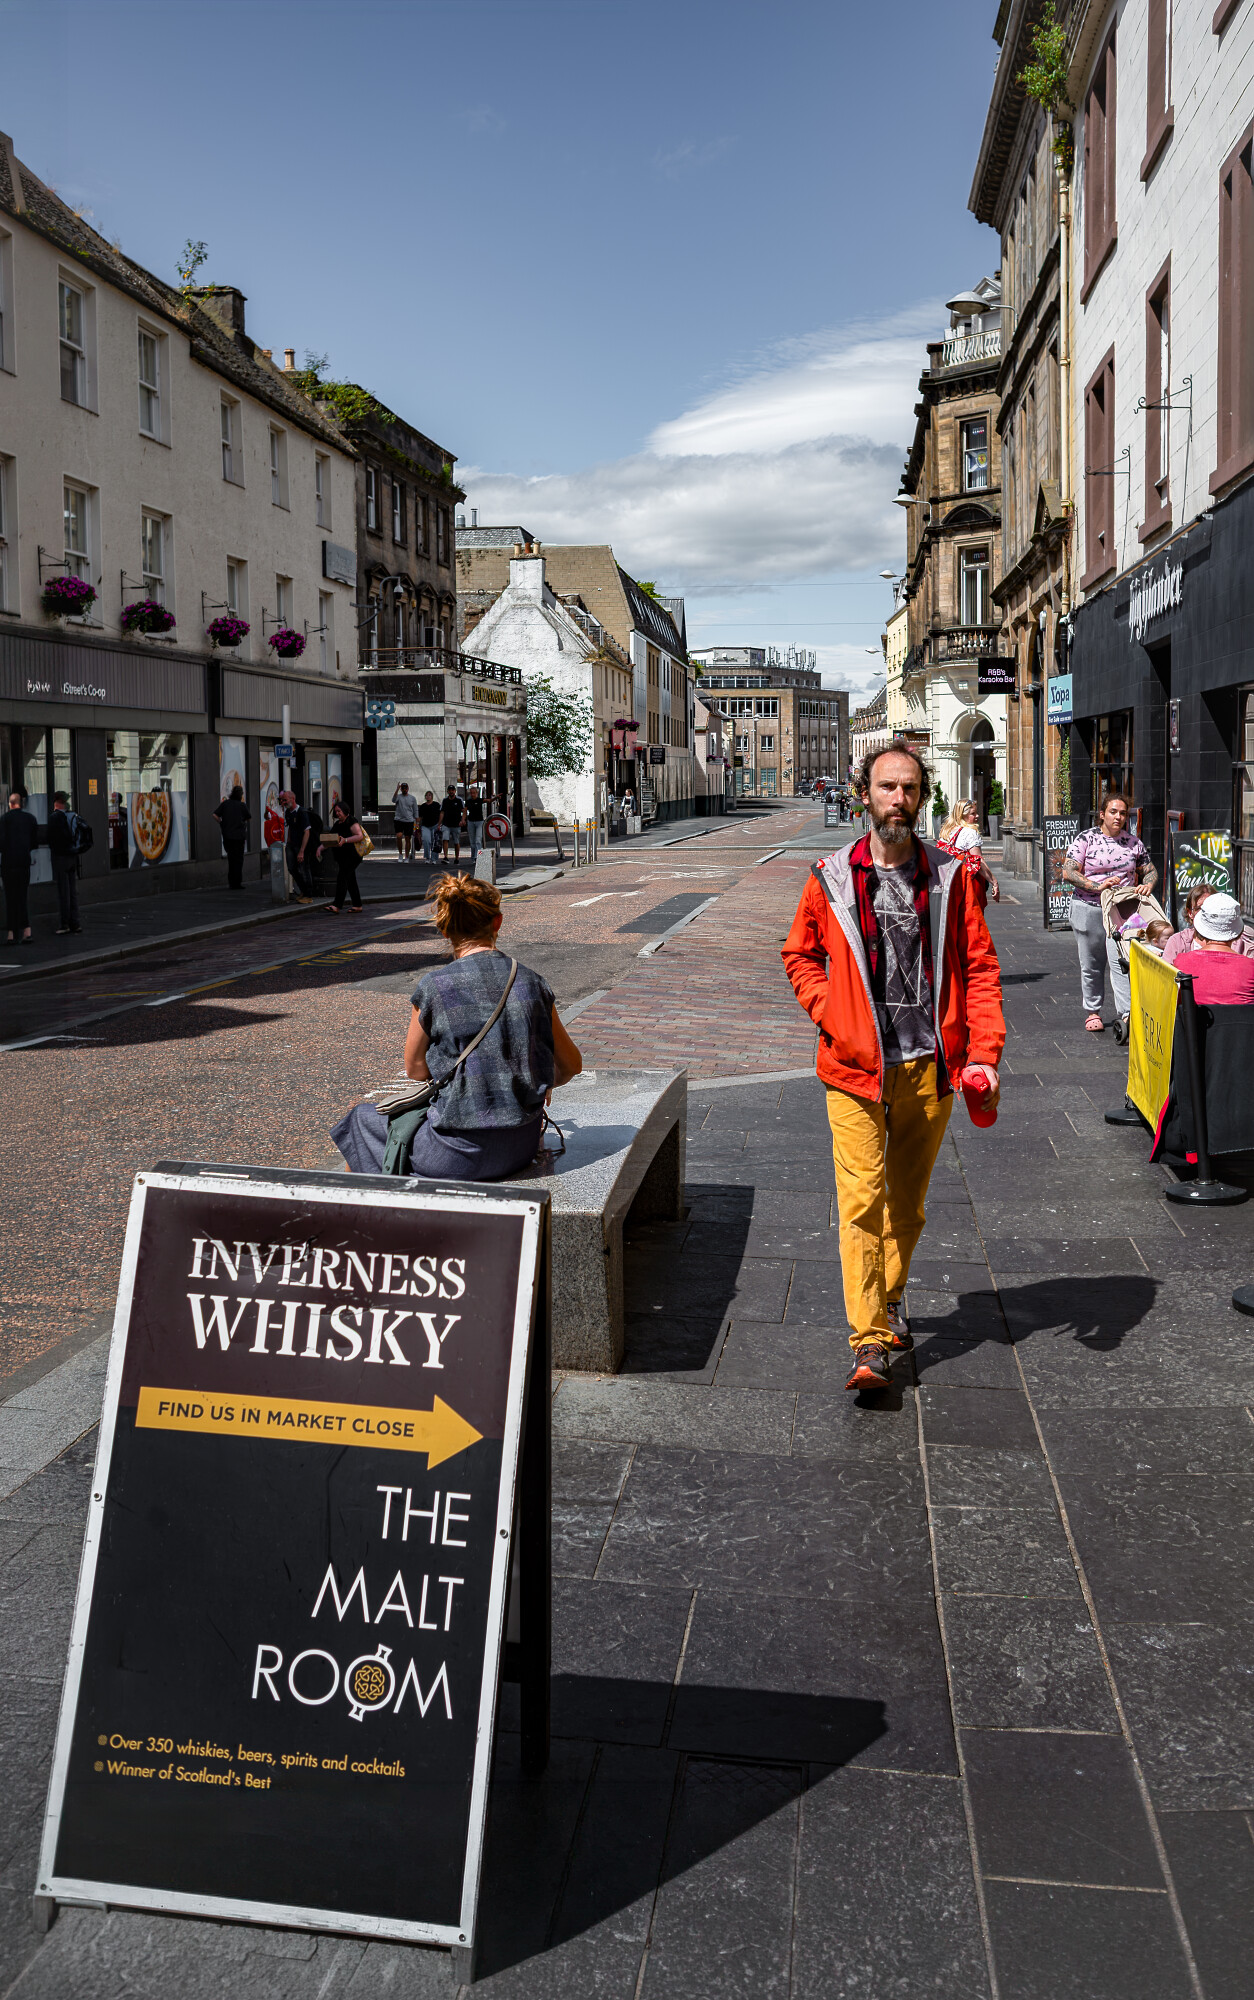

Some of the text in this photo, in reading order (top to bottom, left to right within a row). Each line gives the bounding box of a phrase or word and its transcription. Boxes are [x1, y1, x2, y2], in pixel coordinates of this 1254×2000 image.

[1051, 686, 1069, 705] Yopa
[1046, 820, 1078, 830] FRESHLY
[1198, 838, 1232, 859] LIVE
[1049, 896, 1071, 908] HAGG
[188, 1238, 466, 1300] INVERNESS
[187, 1293, 461, 1369] WHISKY
[158, 1401, 415, 1438] FIND US IN MARKET CLOSE
[376, 1485, 471, 1547] THE
[311, 1562, 464, 1631] MALT
[251, 1643, 453, 1722] ROOM
[107, 1760, 156, 1778] Winner
[158, 1763, 174, 1780] of
[175, 1766, 241, 1786] Scotland's
[109, 1734, 406, 1777] Over 350 whiskies, beers, spirits and cocktails
